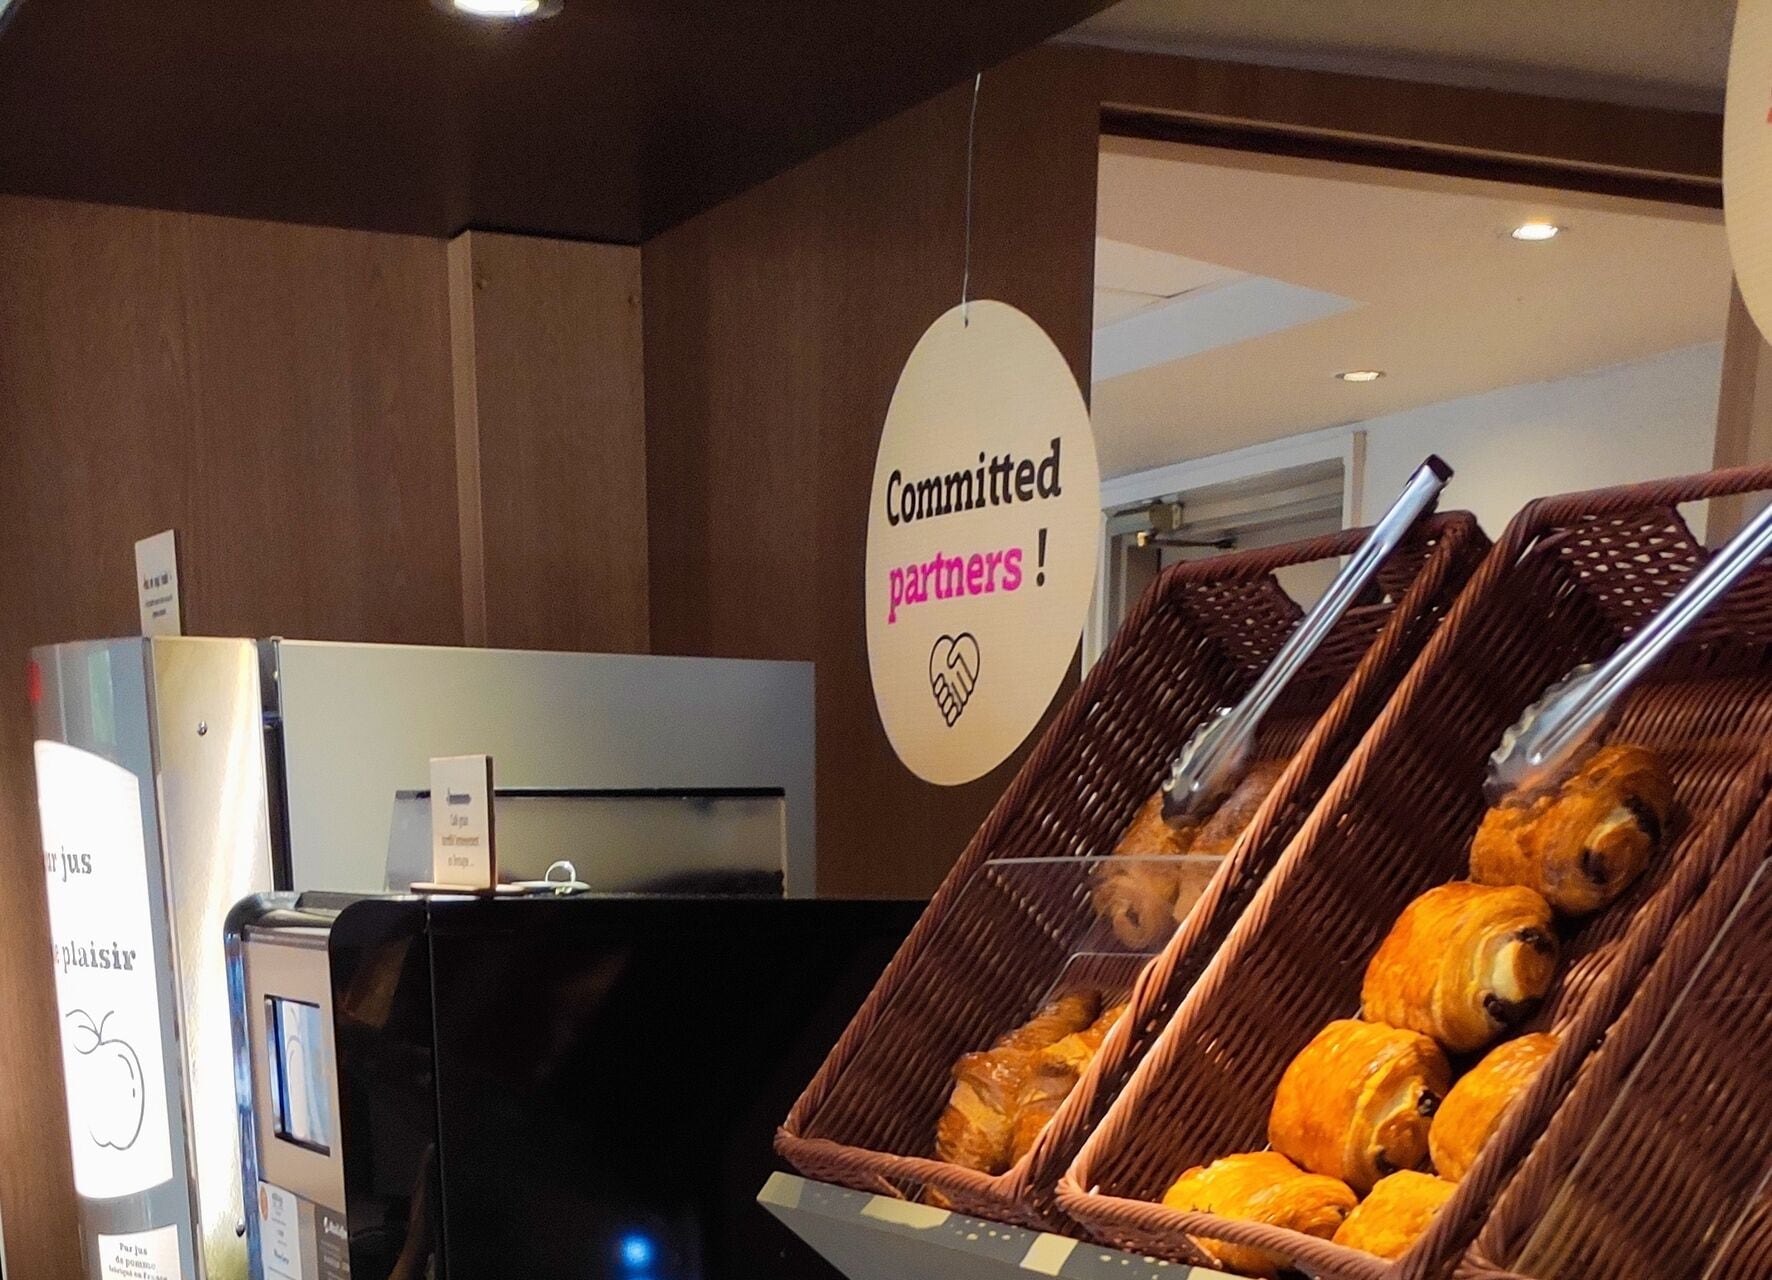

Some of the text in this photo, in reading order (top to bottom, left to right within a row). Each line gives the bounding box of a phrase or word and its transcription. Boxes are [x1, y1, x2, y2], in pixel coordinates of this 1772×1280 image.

[887, 437, 1061, 526] Committed
[888, 528, 1048, 624] partners !
[61, 845, 92, 882] jus
[62, 940, 136, 974] plaisir
[119, 1242, 148, 1257] Pur jus
[125, 1258, 157, 1271] pomme
